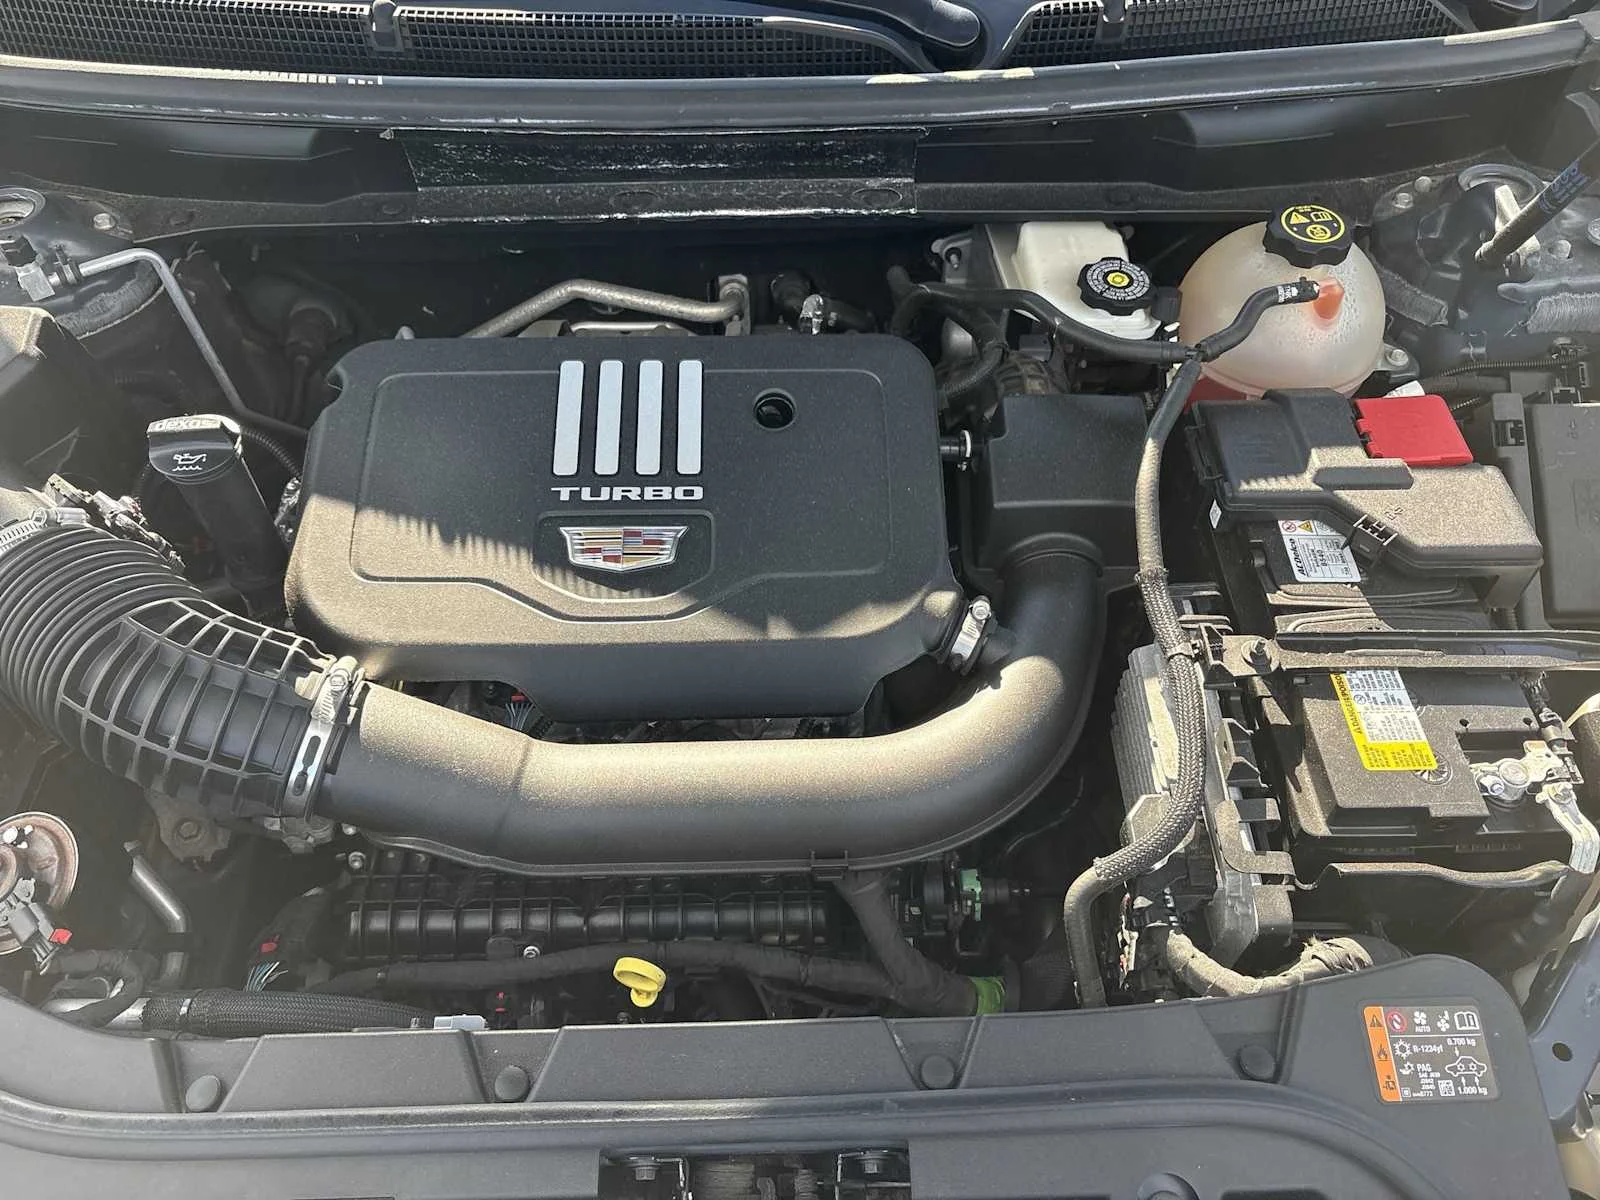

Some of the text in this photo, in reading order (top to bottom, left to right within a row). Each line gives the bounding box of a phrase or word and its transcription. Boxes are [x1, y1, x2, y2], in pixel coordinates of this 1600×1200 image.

[551, 486, 703, 501] TURBO
[1289, 538, 1306, 576] ACDelco
[1466, 1037, 1476, 1047] kg
[1413, 1044, 1443, 1054] R-1234yf
[1416, 1064, 1432, 1072] PAG
[1458, 1086, 1488, 1096] 1.000 kg
